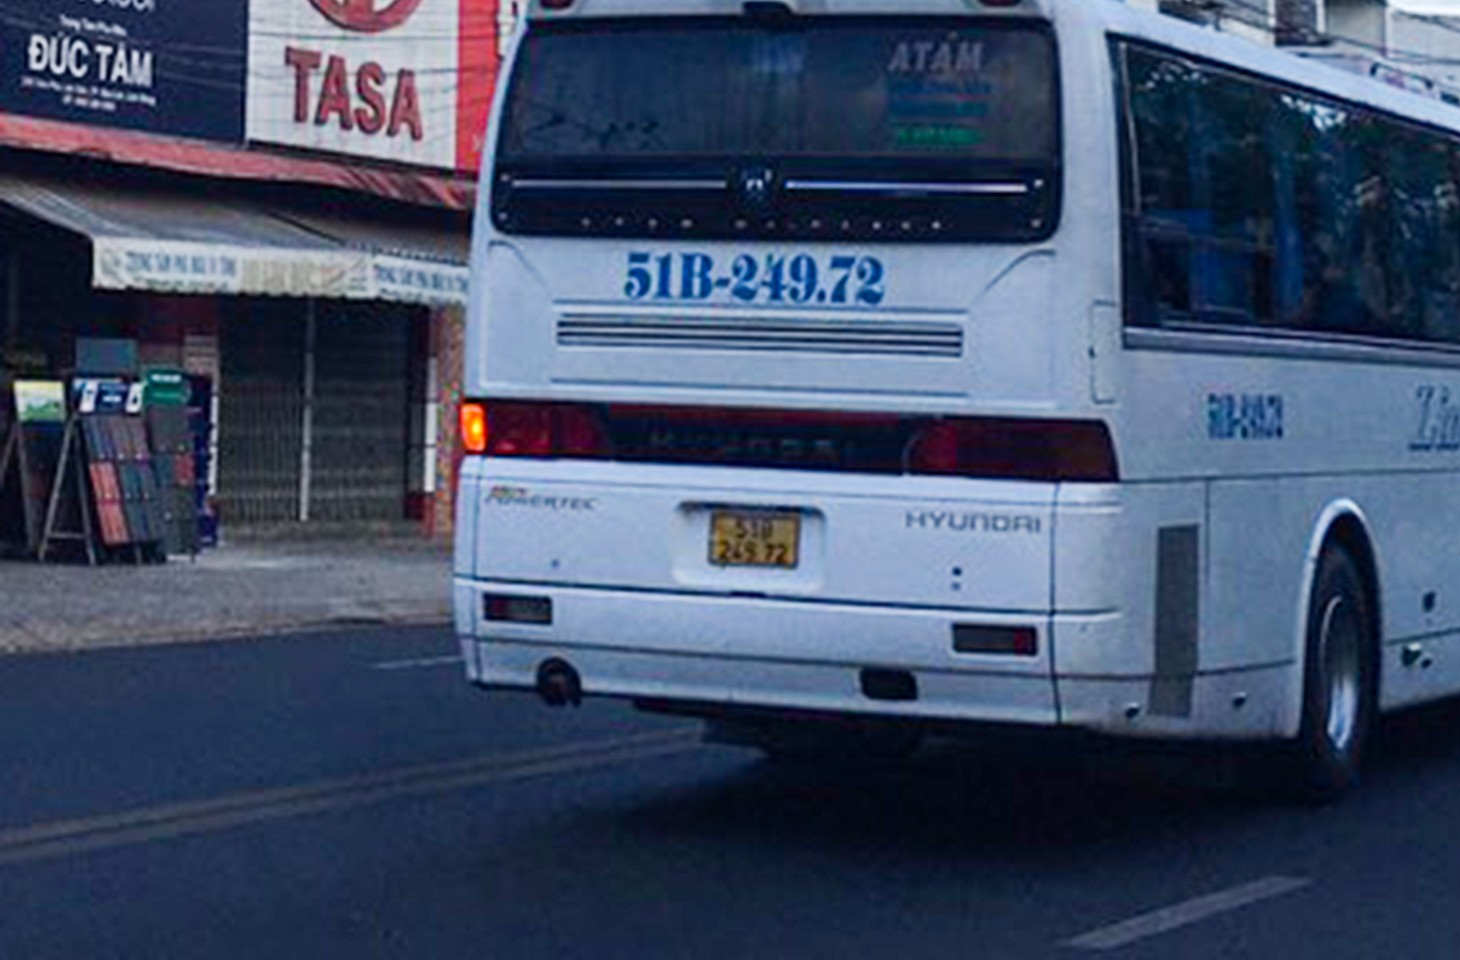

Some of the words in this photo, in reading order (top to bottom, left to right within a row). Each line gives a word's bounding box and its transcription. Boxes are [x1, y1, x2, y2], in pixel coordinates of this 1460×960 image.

[28, 31, 90, 78] ĐỨC
[285, 46, 424, 142] TASA
[624, 251, 885, 305] 51B-249.72
[904, 510, 1042, 534] HYUNDAI
